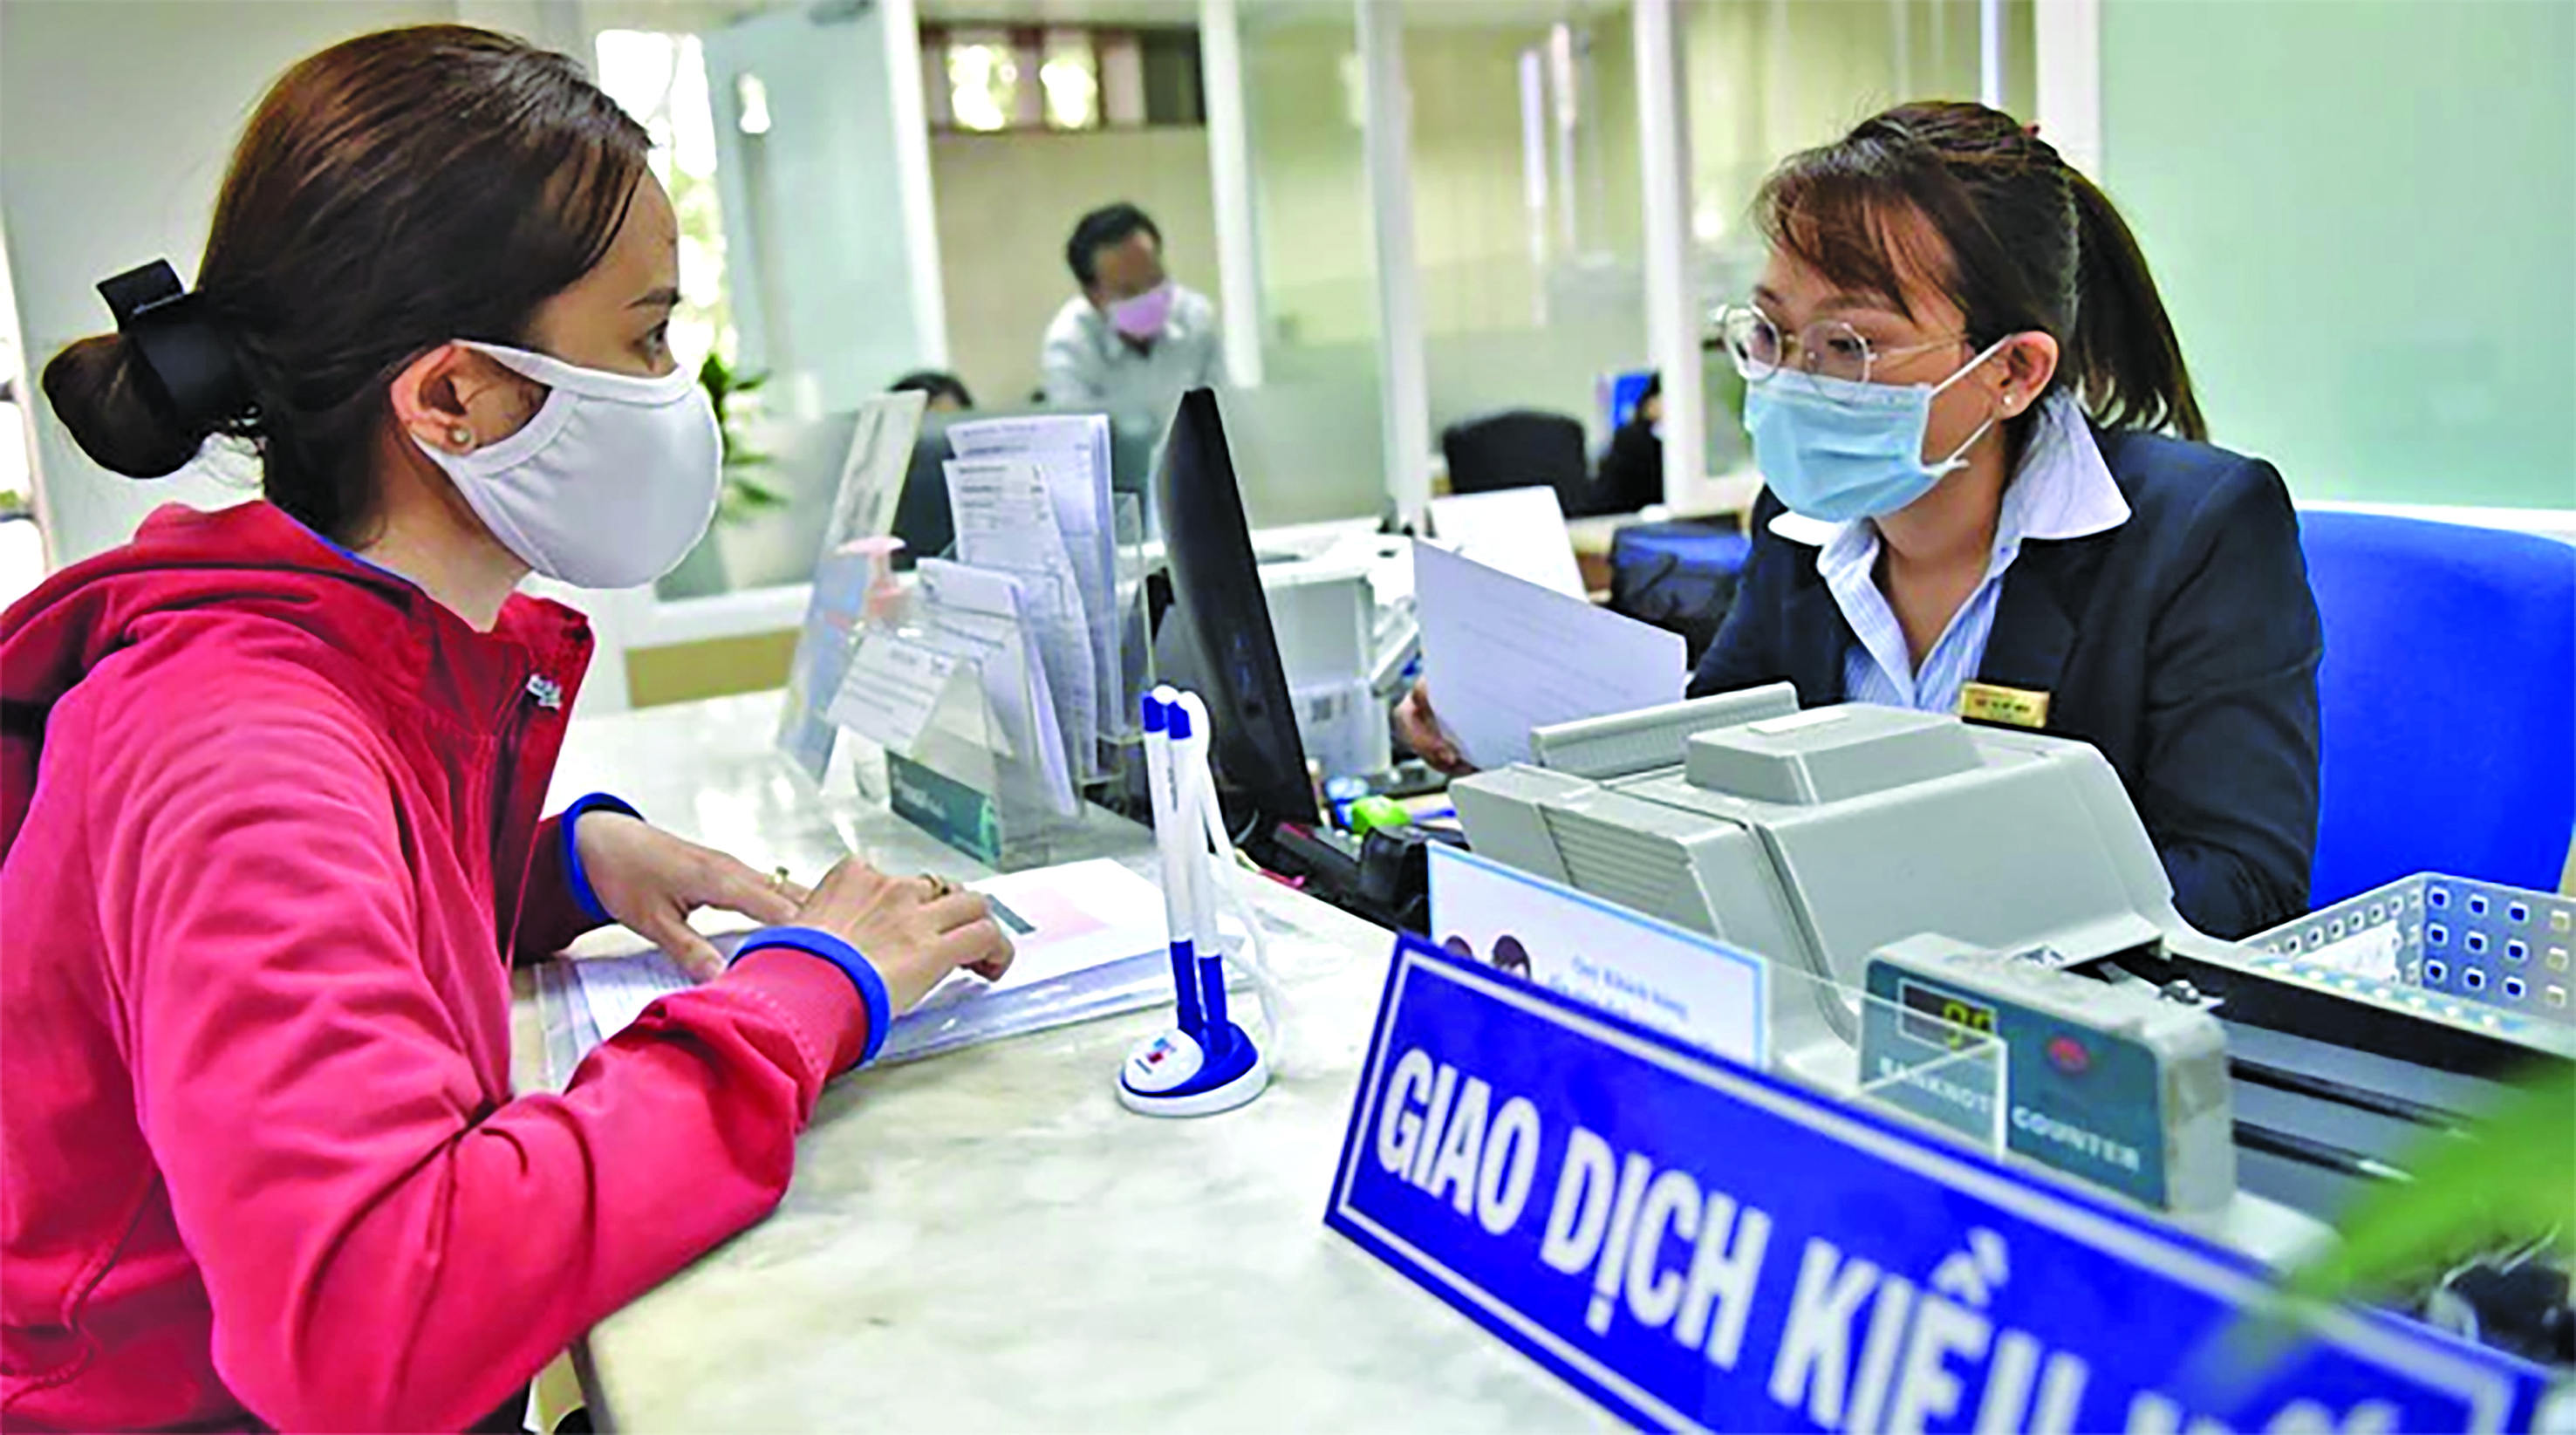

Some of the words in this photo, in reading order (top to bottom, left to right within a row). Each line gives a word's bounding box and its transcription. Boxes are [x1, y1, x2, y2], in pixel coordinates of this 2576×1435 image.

[1377, 1048, 1541, 1235] GIAO
[1539, 1125, 1772, 1371] DỊCH
[1879, 1056, 1994, 1113] BANKNOT
[2011, 1105, 2141, 1172] COUNTER
